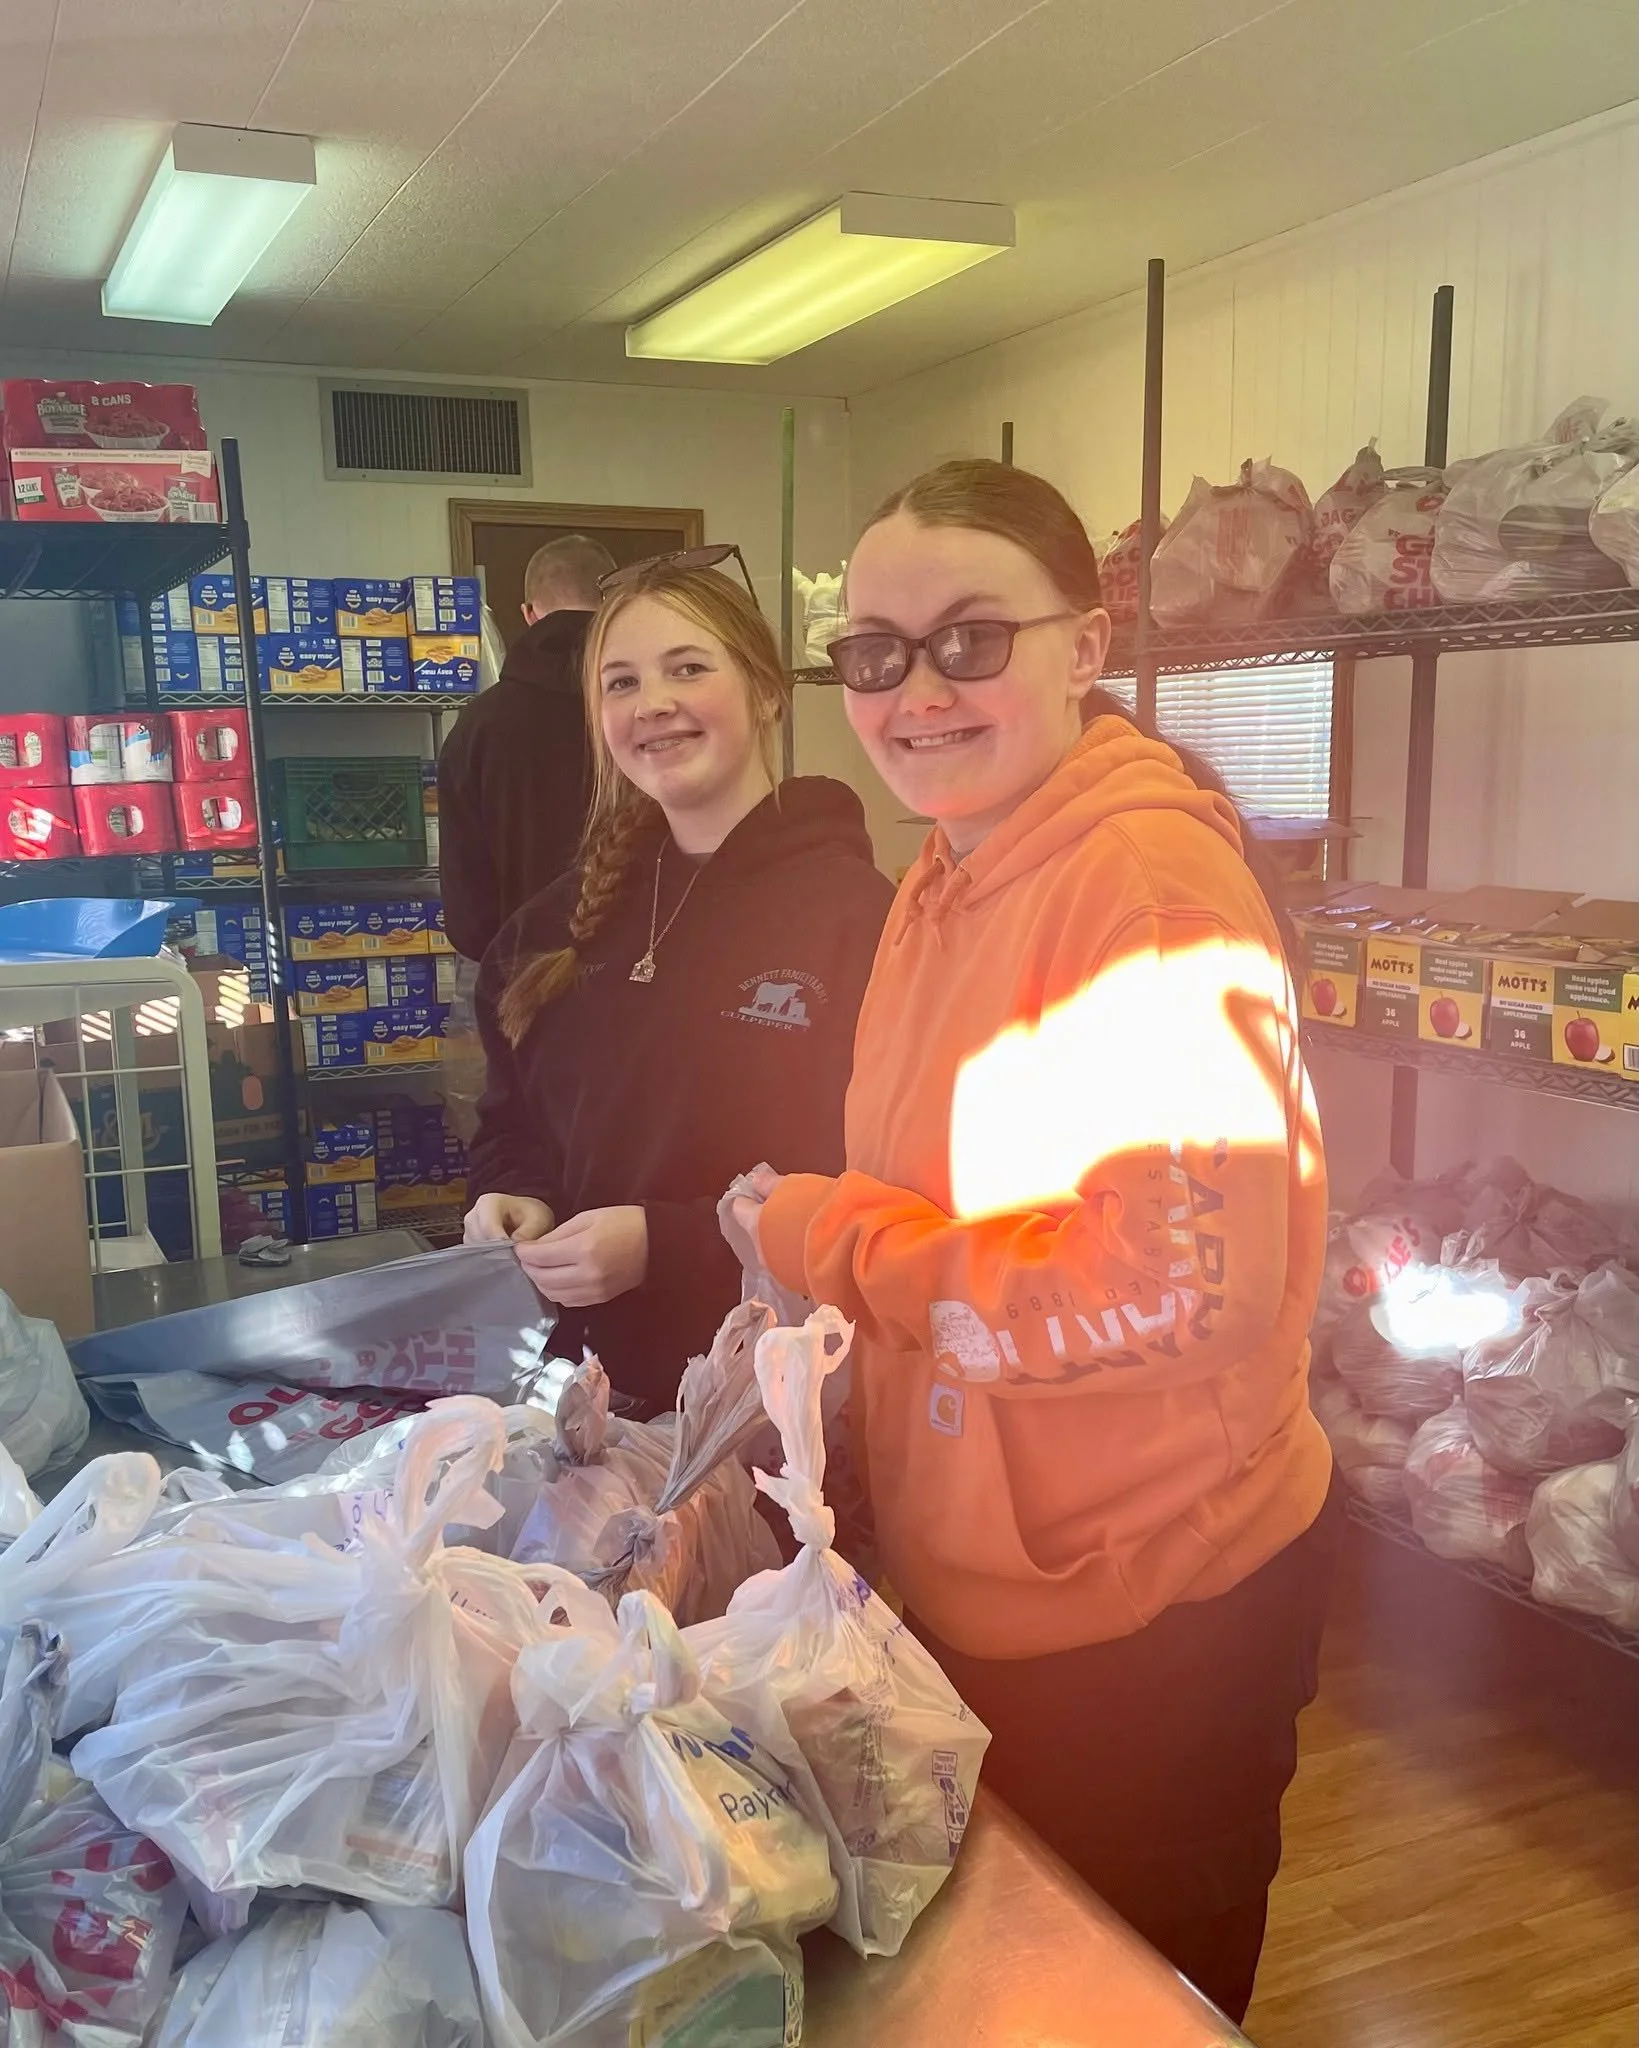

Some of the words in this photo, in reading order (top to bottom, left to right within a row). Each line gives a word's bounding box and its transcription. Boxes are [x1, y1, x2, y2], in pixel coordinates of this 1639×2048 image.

[102, 394, 132, 406] CANS
[17, 484, 25, 493] 12
[1371, 958, 1414, 974] MOTT'S
[1434, 958, 1448, 966] Real
[325, 974, 342, 982] easy
[738, 969, 780, 992] BENNETT
[1571, 974, 1586, 983] Real
[1586, 977, 1610, 986] apples
[1497, 975, 1547, 993] MOTT'S
[1564, 983, 1583, 991] make
[1583, 985, 1598, 993] real
[1598, 987, 1616, 996] good
[1525, 1003, 1543, 1011] ADDED
[1503, 1010, 1538, 1021] APPLESAUCE
[392, 1024, 409, 1032] easy
[1381, 1019, 1400, 1027] APPLE
[1514, 1029, 1526, 1039] 36
[1510, 1041, 1531, 1050] APPLE
